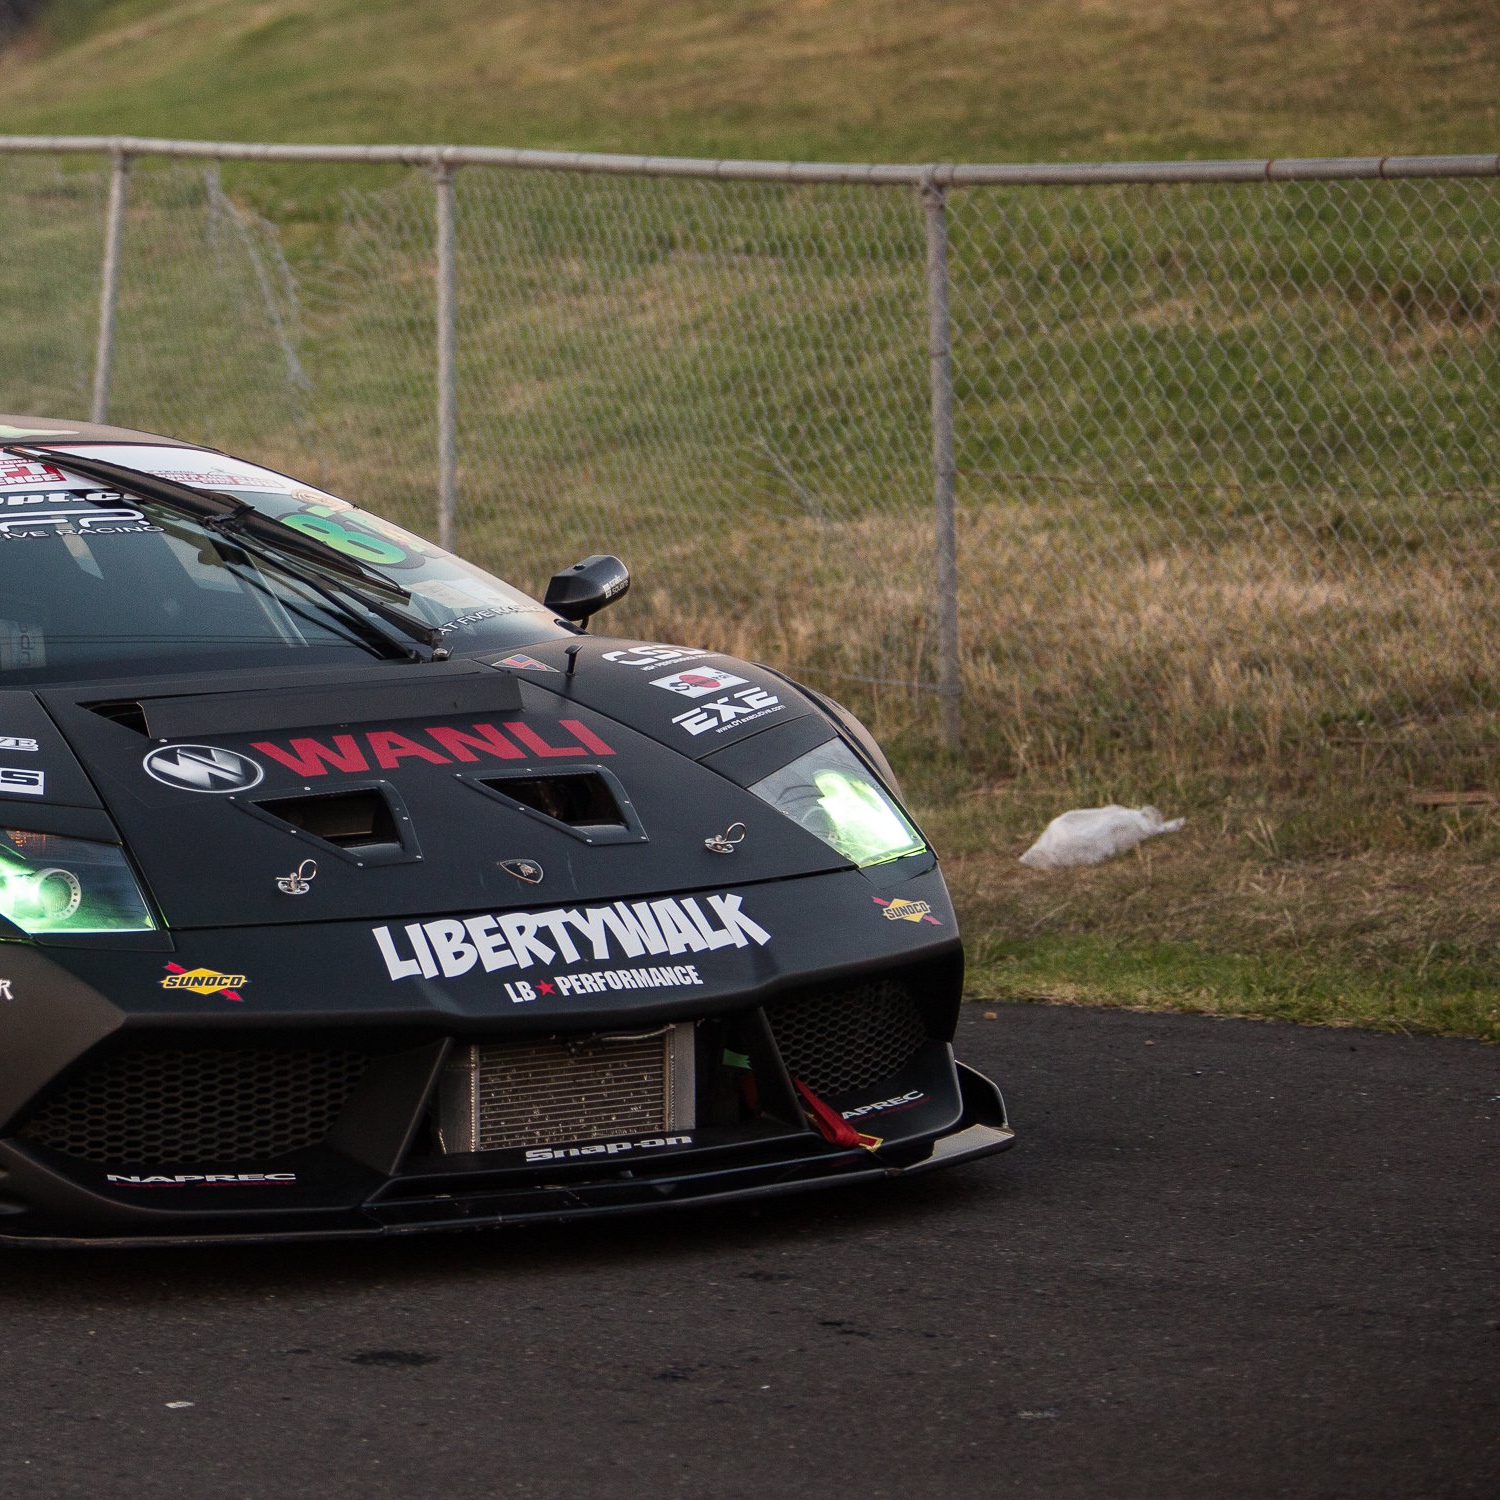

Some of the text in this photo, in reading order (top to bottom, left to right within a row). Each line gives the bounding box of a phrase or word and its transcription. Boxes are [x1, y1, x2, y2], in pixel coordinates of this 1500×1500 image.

[56, 525, 165, 536] RACING
[457, 610, 495, 625] FIVE
[671, 687, 779, 736] EXE
[249, 719, 618, 777] WANLI
[885, 902, 929, 919] SUNOCO
[372, 893, 772, 982] LIBERTYWALK
[165, 975, 244, 987] SUNOCO
[840, 1090, 925, 1120] APREC
[525, 1134, 693, 1162] Snap-on
[106, 1173, 296, 1183] NAPREC
